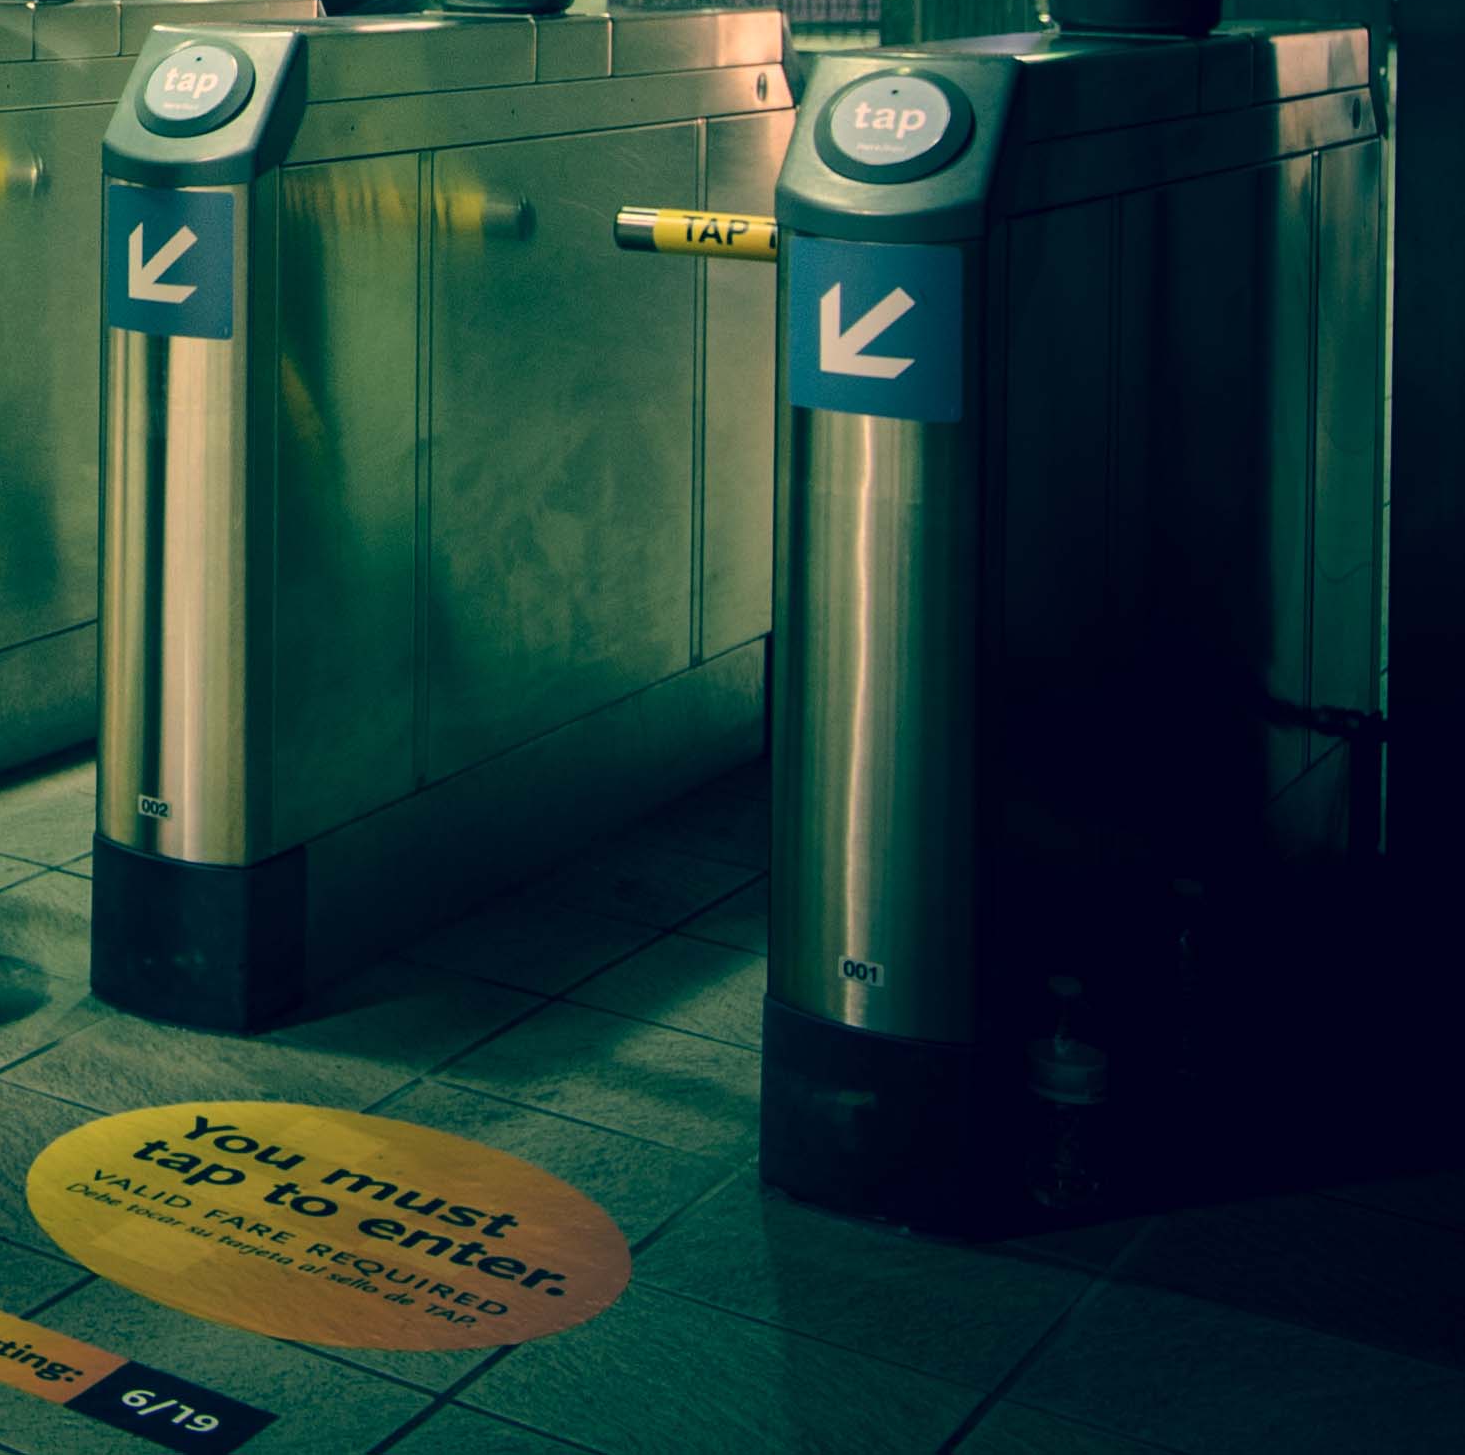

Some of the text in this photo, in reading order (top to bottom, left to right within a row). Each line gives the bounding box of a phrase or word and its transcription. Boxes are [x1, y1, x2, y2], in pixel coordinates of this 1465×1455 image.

[164, 66, 219, 99] tap
[854, 100, 926, 140] tap
[684, 215, 749, 245] TAP
[142, 799, 168, 817] 002
[843, 960, 877, 983] 001
[184, 1115, 519, 1238] You must
[133, 1140, 566, 1296] tap to enter.
[66, 1182, 478, 1328] Debe tocar su tarjeta al sello de TAP.
[93, 1169, 509, 1315] VALID FARE REQUIRED
[120, 1389, 220, 1434] 6/19
